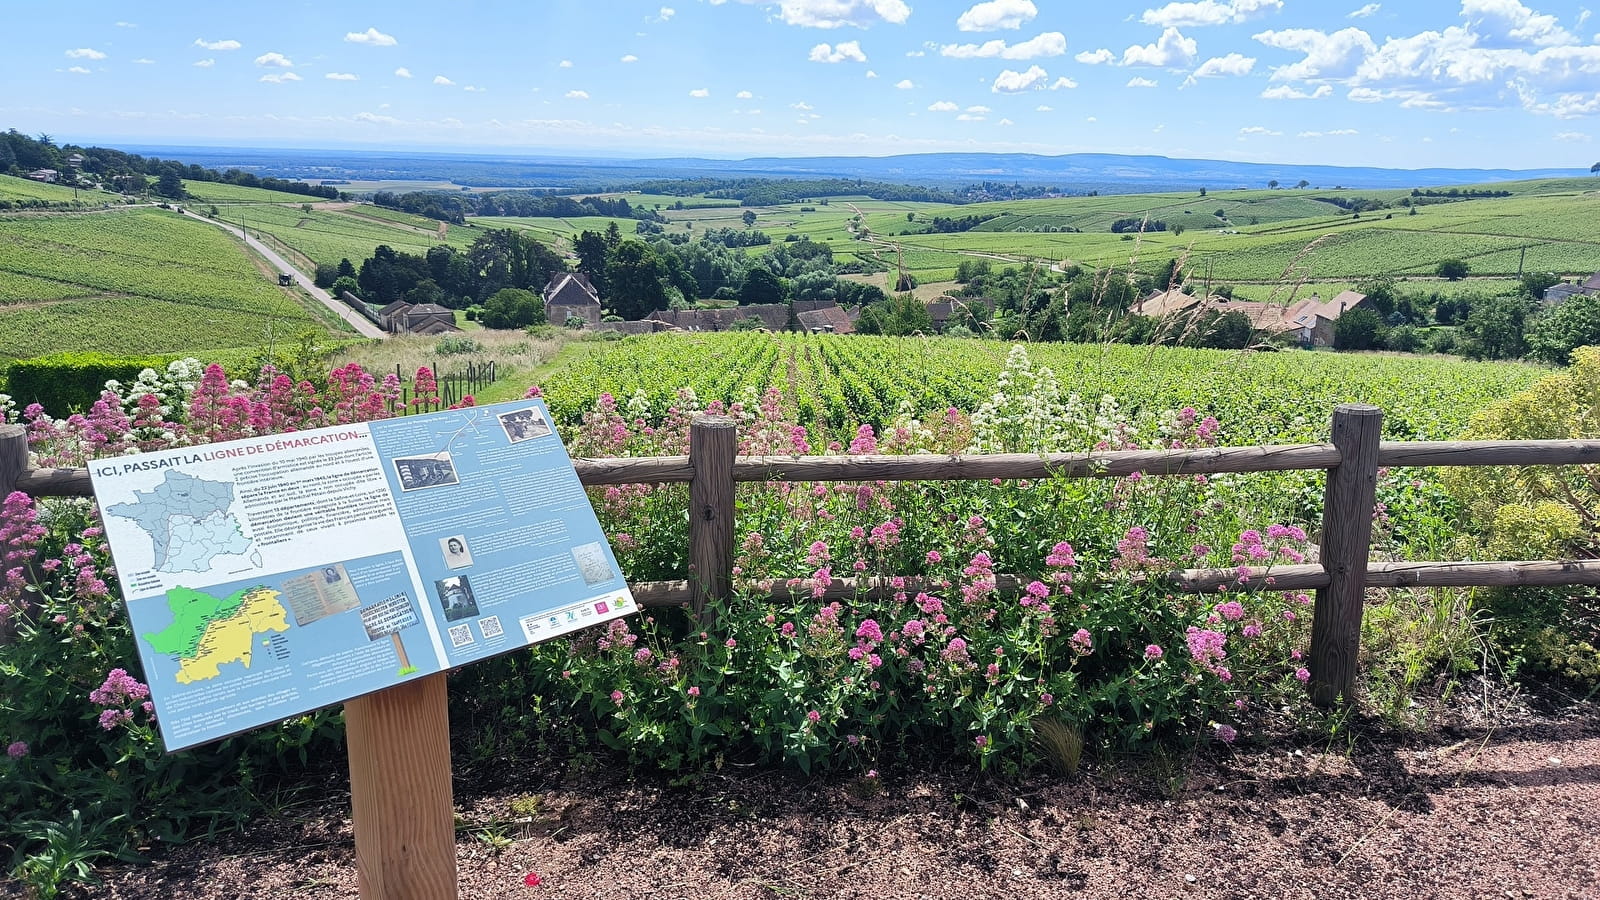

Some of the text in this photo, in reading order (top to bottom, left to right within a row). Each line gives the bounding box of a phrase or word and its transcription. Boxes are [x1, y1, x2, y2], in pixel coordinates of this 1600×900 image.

[96, 465, 122, 478] ICI,
[123, 456, 182, 473] PASSAIT
[183, 453, 202, 464] LA
[203, 447, 244, 461] LIGNE
[245, 444, 264, 454] DE
